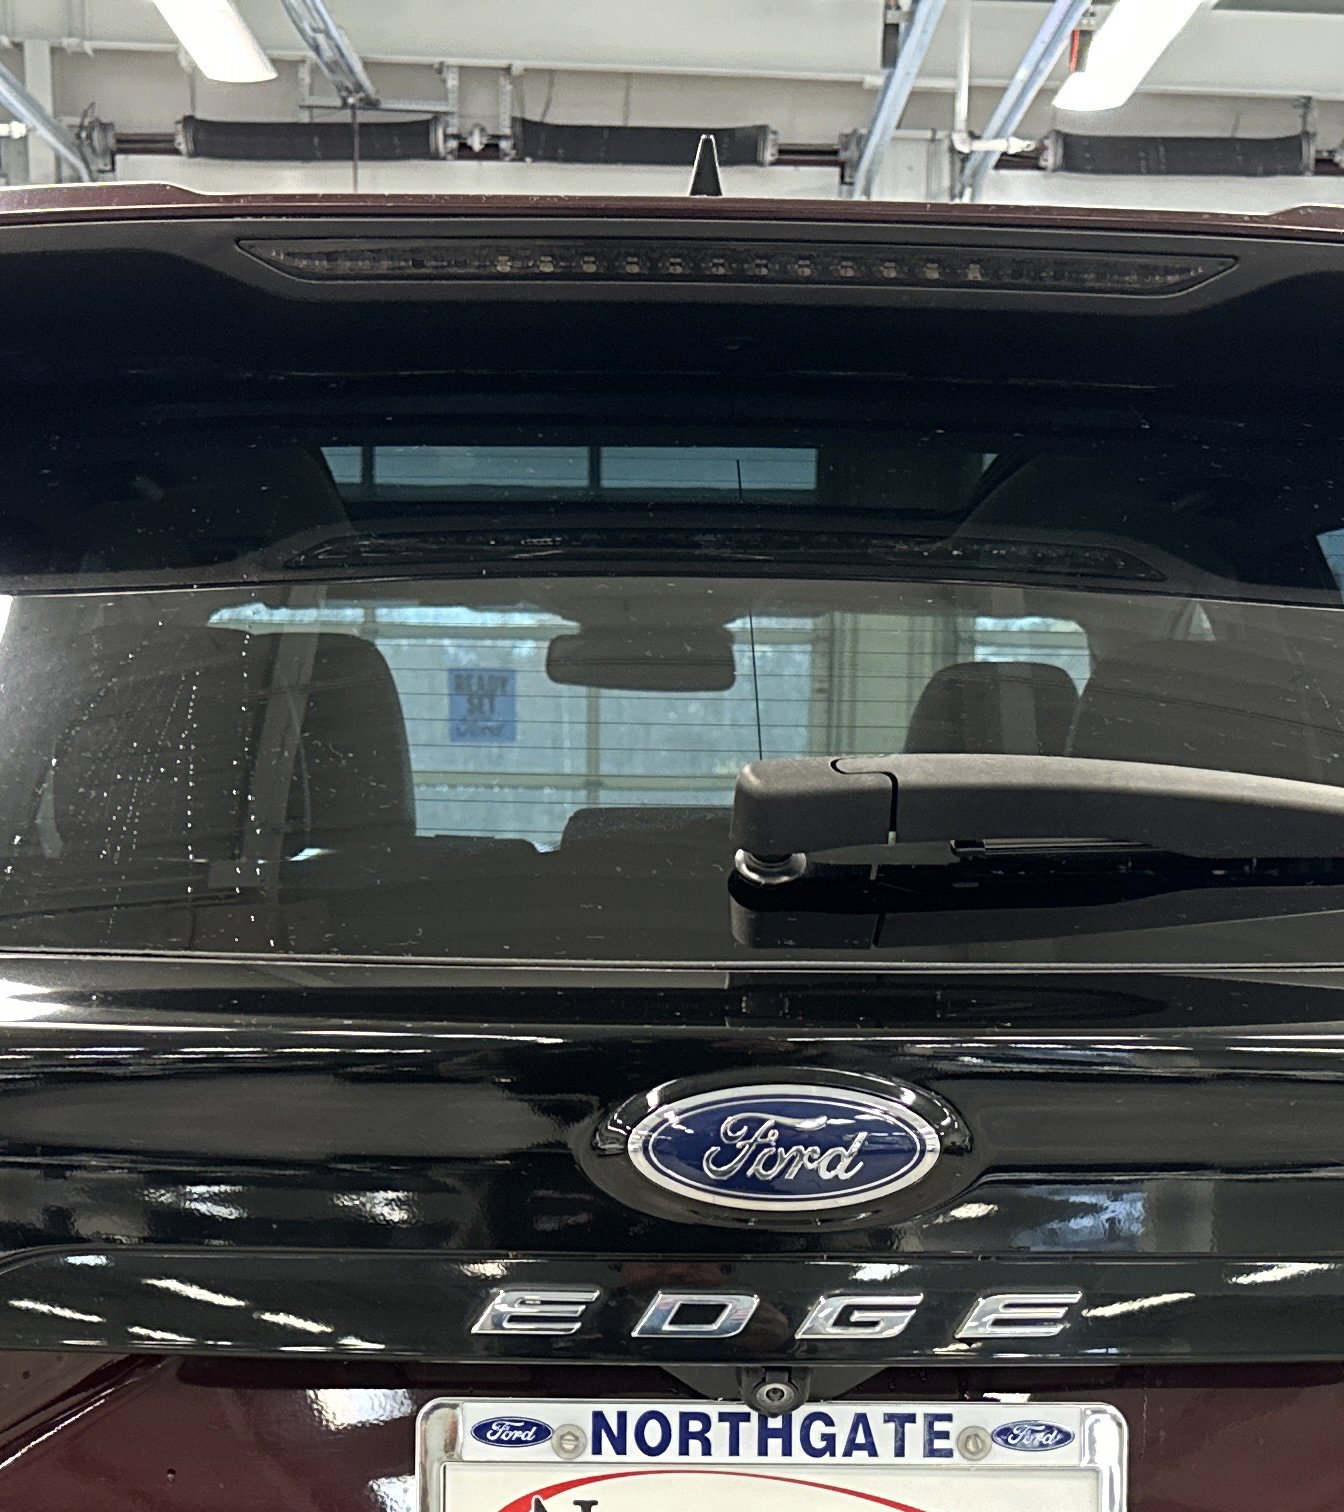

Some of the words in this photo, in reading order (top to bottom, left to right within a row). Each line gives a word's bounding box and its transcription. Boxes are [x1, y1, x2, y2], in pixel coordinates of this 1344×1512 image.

[702, 1110, 870, 1183] Ford
[470, 1288, 1084, 1340] EDGE
[486, 1420, 537, 1441] Ford
[589, 1410, 954, 1459] NORTHGATE
[1007, 1424, 1059, 1445] Ford
